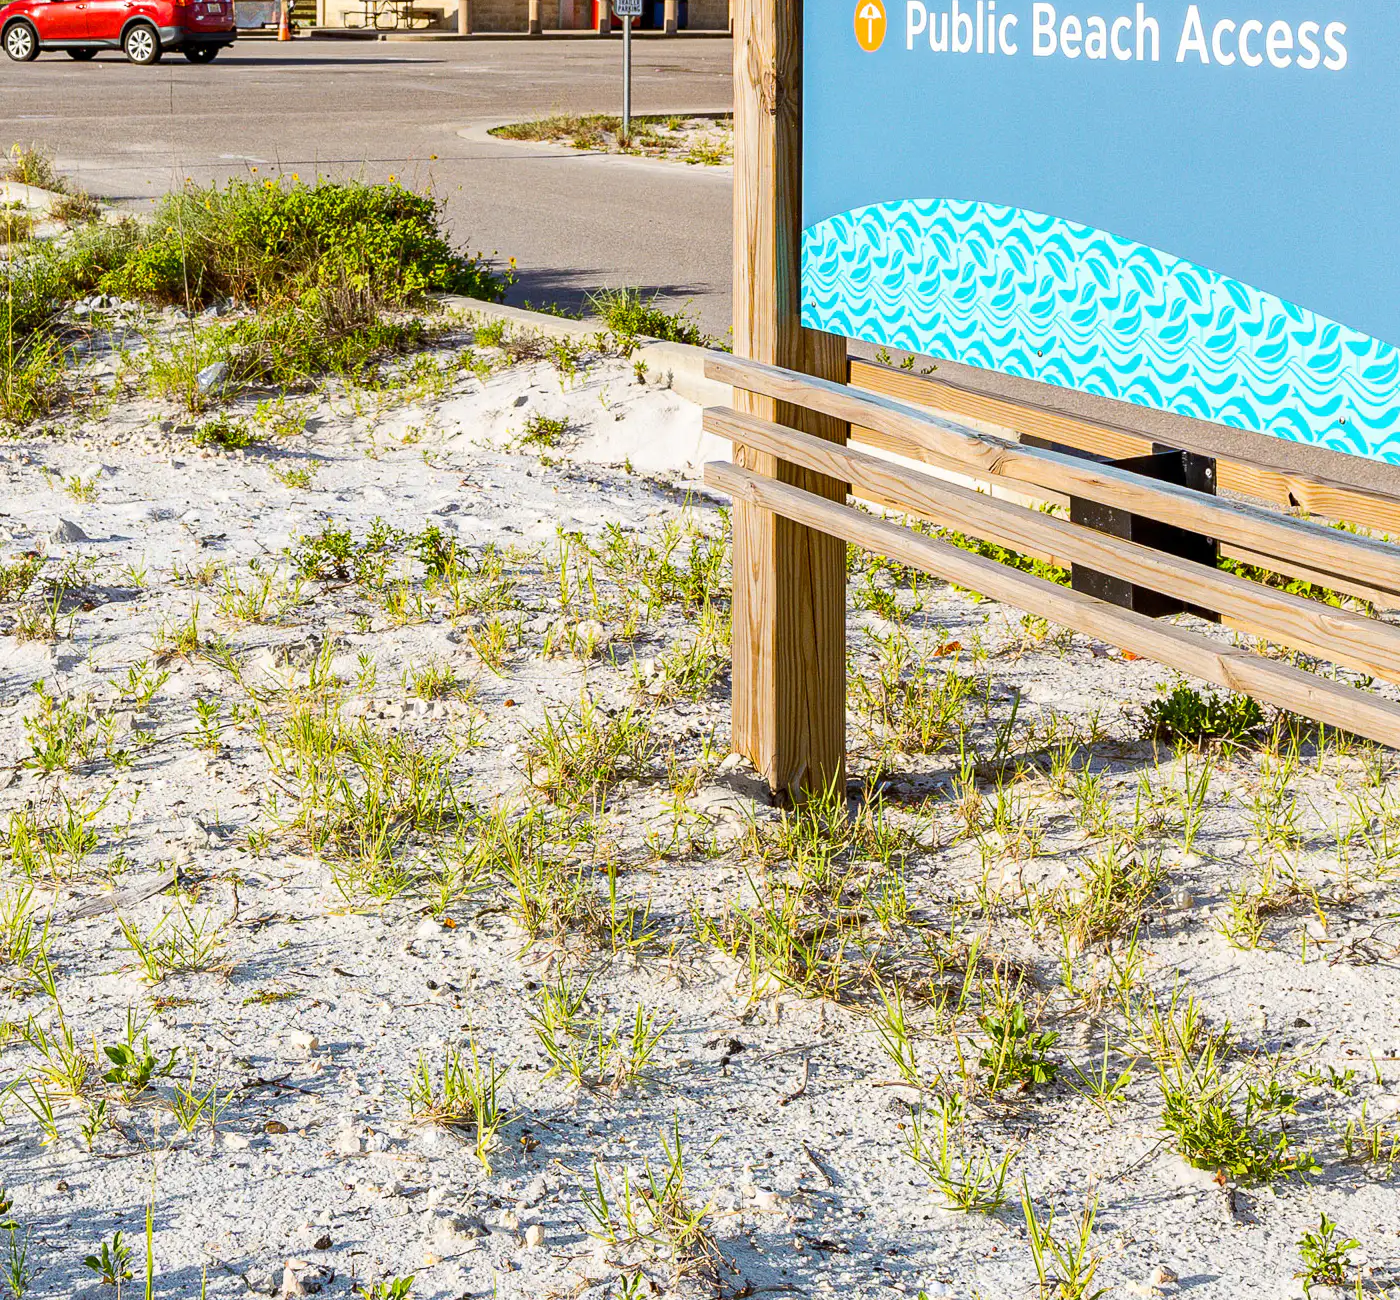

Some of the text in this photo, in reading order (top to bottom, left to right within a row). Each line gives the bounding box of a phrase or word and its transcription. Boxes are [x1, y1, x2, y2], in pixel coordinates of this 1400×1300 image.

[906, 0, 1348, 71] Public Beach Access
